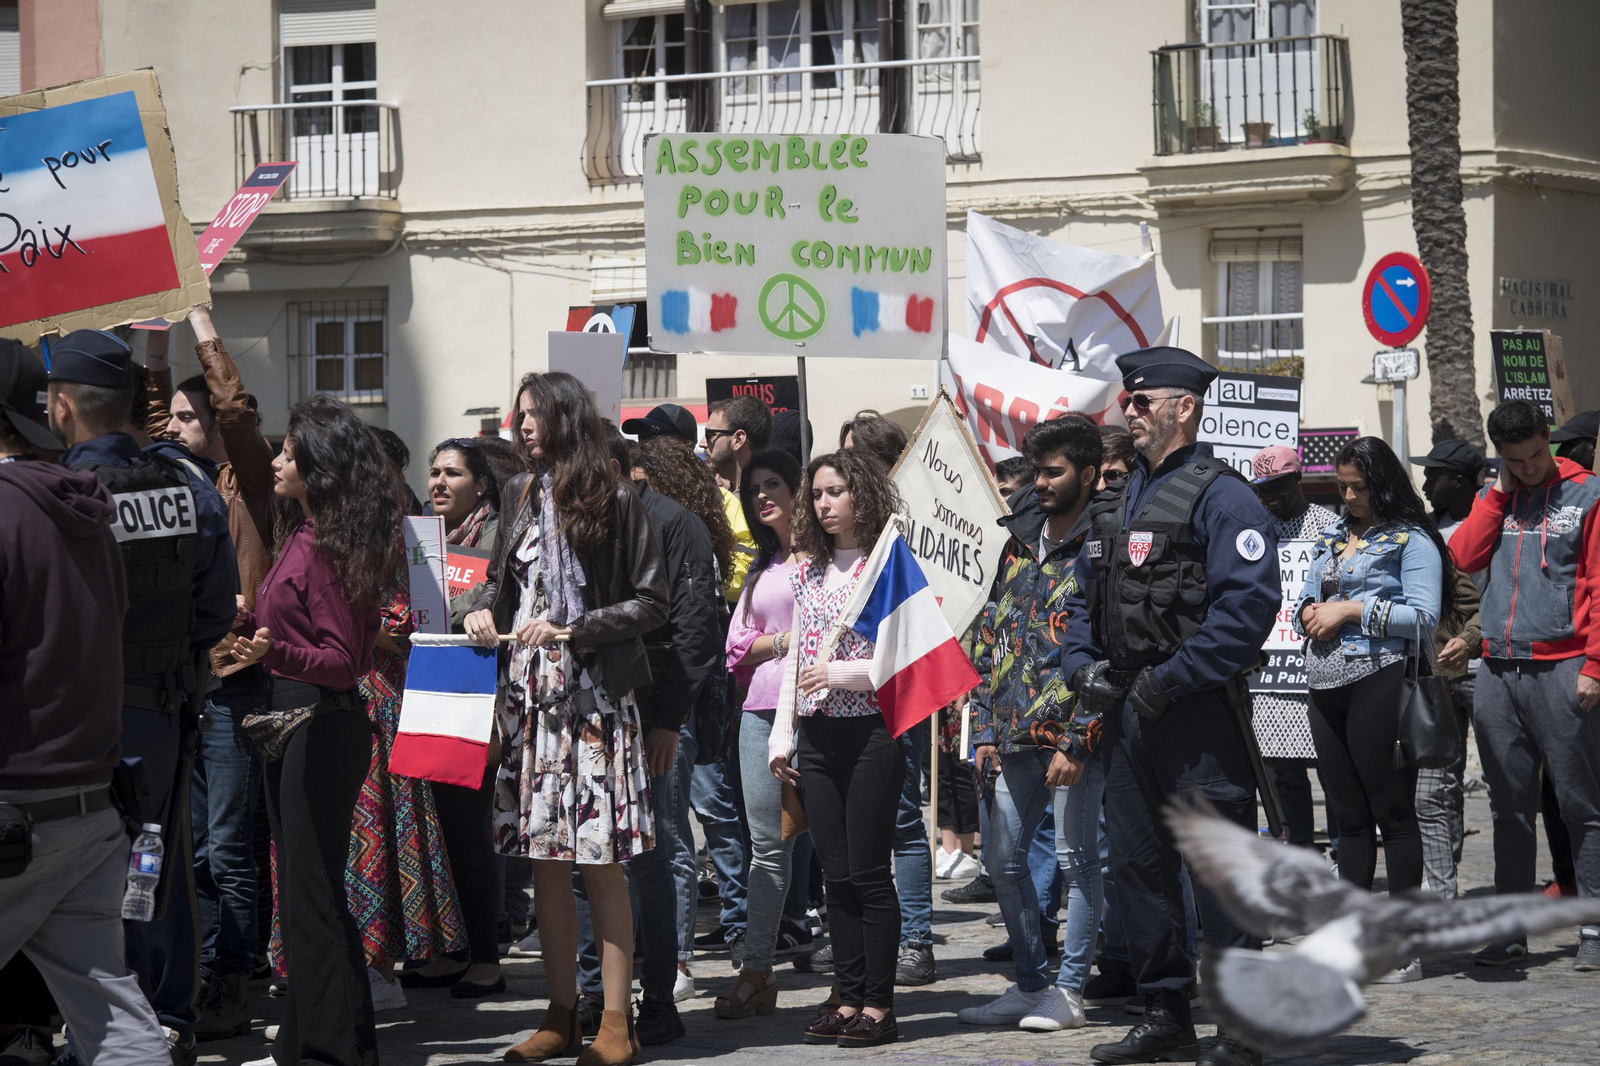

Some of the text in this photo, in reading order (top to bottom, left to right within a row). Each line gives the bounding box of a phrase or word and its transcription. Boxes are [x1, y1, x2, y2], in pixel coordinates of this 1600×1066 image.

[41, 138, 112, 190] pour
[213, 193, 269, 229] STOP
[678, 184, 859, 223] POUR le
[791, 240, 932, 274] COMMUN
[1501, 278, 1574, 300] MAGISTRAL
[1510, 299, 1567, 319] CABRERA
[1502, 338, 1541, 351] PAS AU
[1502, 355, 1545, 368] NOM DE
[1504, 371, 1547, 384] L'ISLAM
[731, 384, 775, 404] NOUS
[1222, 382, 1253, 401] au
[1259, 389, 1297, 400] terrorisme,
[1503, 385, 1553, 401] ARRÊTEZ
[1197, 412, 1297, 445] olence,
[922, 438, 964, 495] Nous
[931, 497, 984, 547] sommes
[1131, 543, 1149, 552] CRS
[1260, 671, 1307, 684] la Paix
